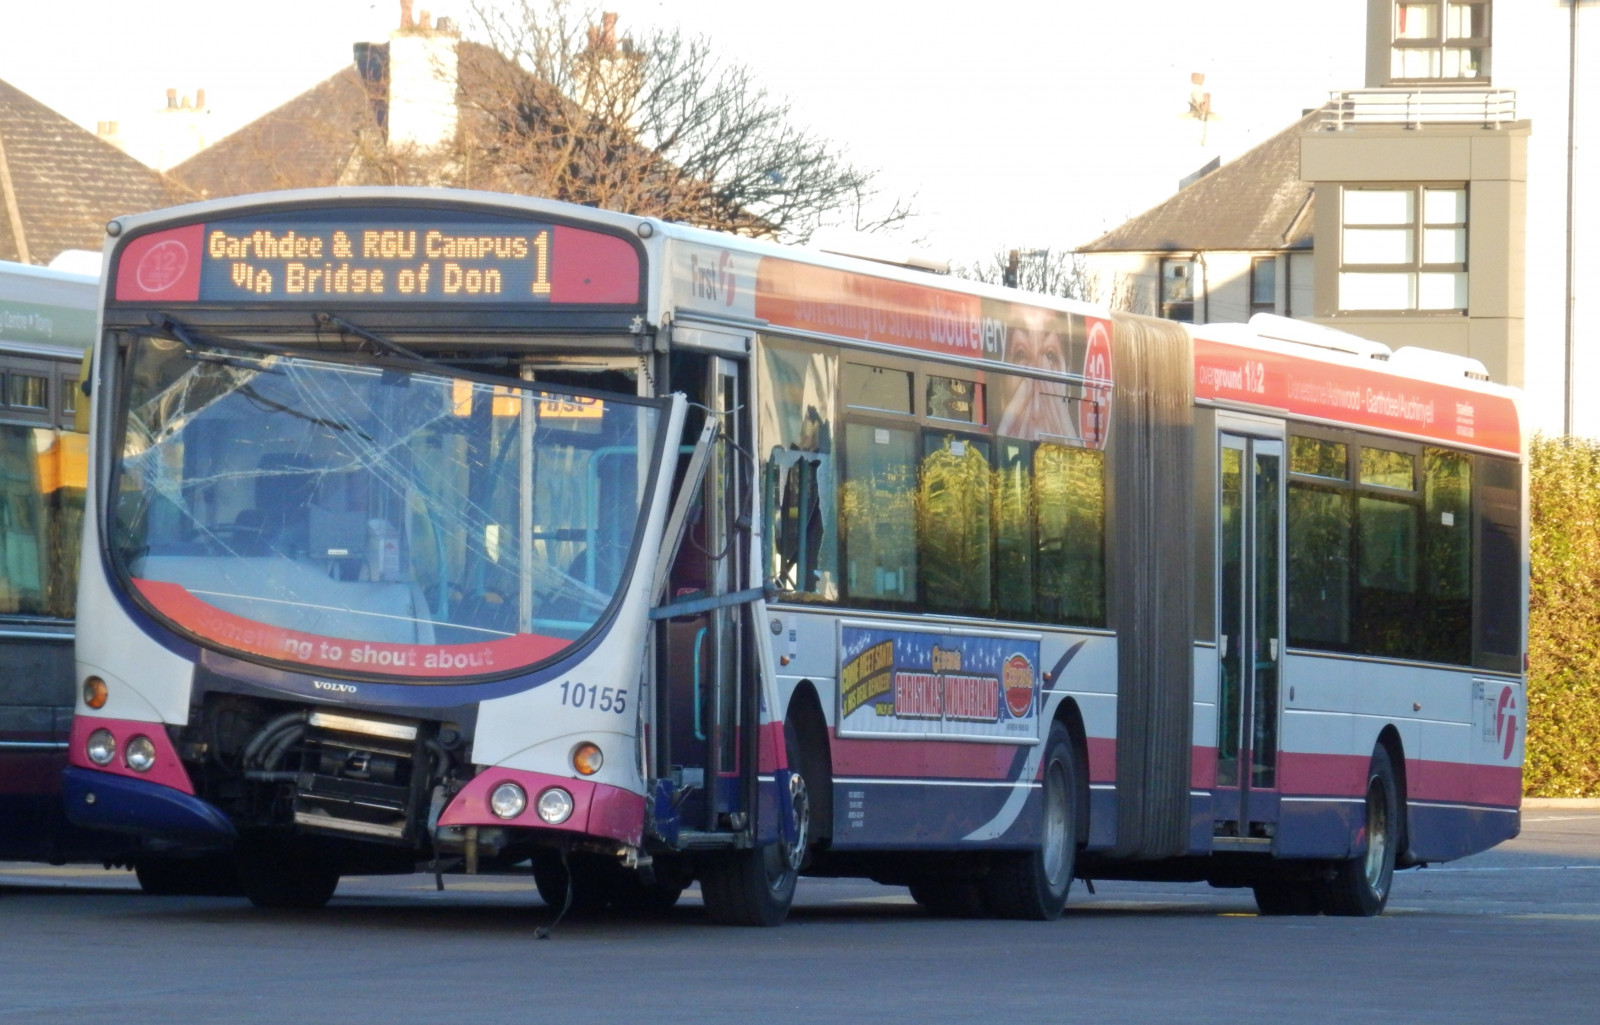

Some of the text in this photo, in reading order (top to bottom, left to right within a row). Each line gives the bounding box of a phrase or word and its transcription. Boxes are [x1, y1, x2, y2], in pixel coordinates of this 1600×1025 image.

[151, 250, 177, 271] 12
[209, 230, 528, 259] Garthdee & RGU Campus
[532, 230, 551, 294] 1
[286, 262, 384, 294] Bridge
[398, 262, 430, 294] of
[443, 262, 502, 294] Don
[690, 253, 717, 301] First
[929, 295, 967, 347] about
[969, 313, 1008, 362] every
[1088, 353, 1106, 407] 12
[1199, 361, 1265, 394] overground 1&2
[197, 606, 495, 669] Something to shout about
[312, 680, 358, 694] VOLVO
[559, 680, 628, 715] 10155
[895, 672, 998, 721] CHRISTMAS WONDERLAND
